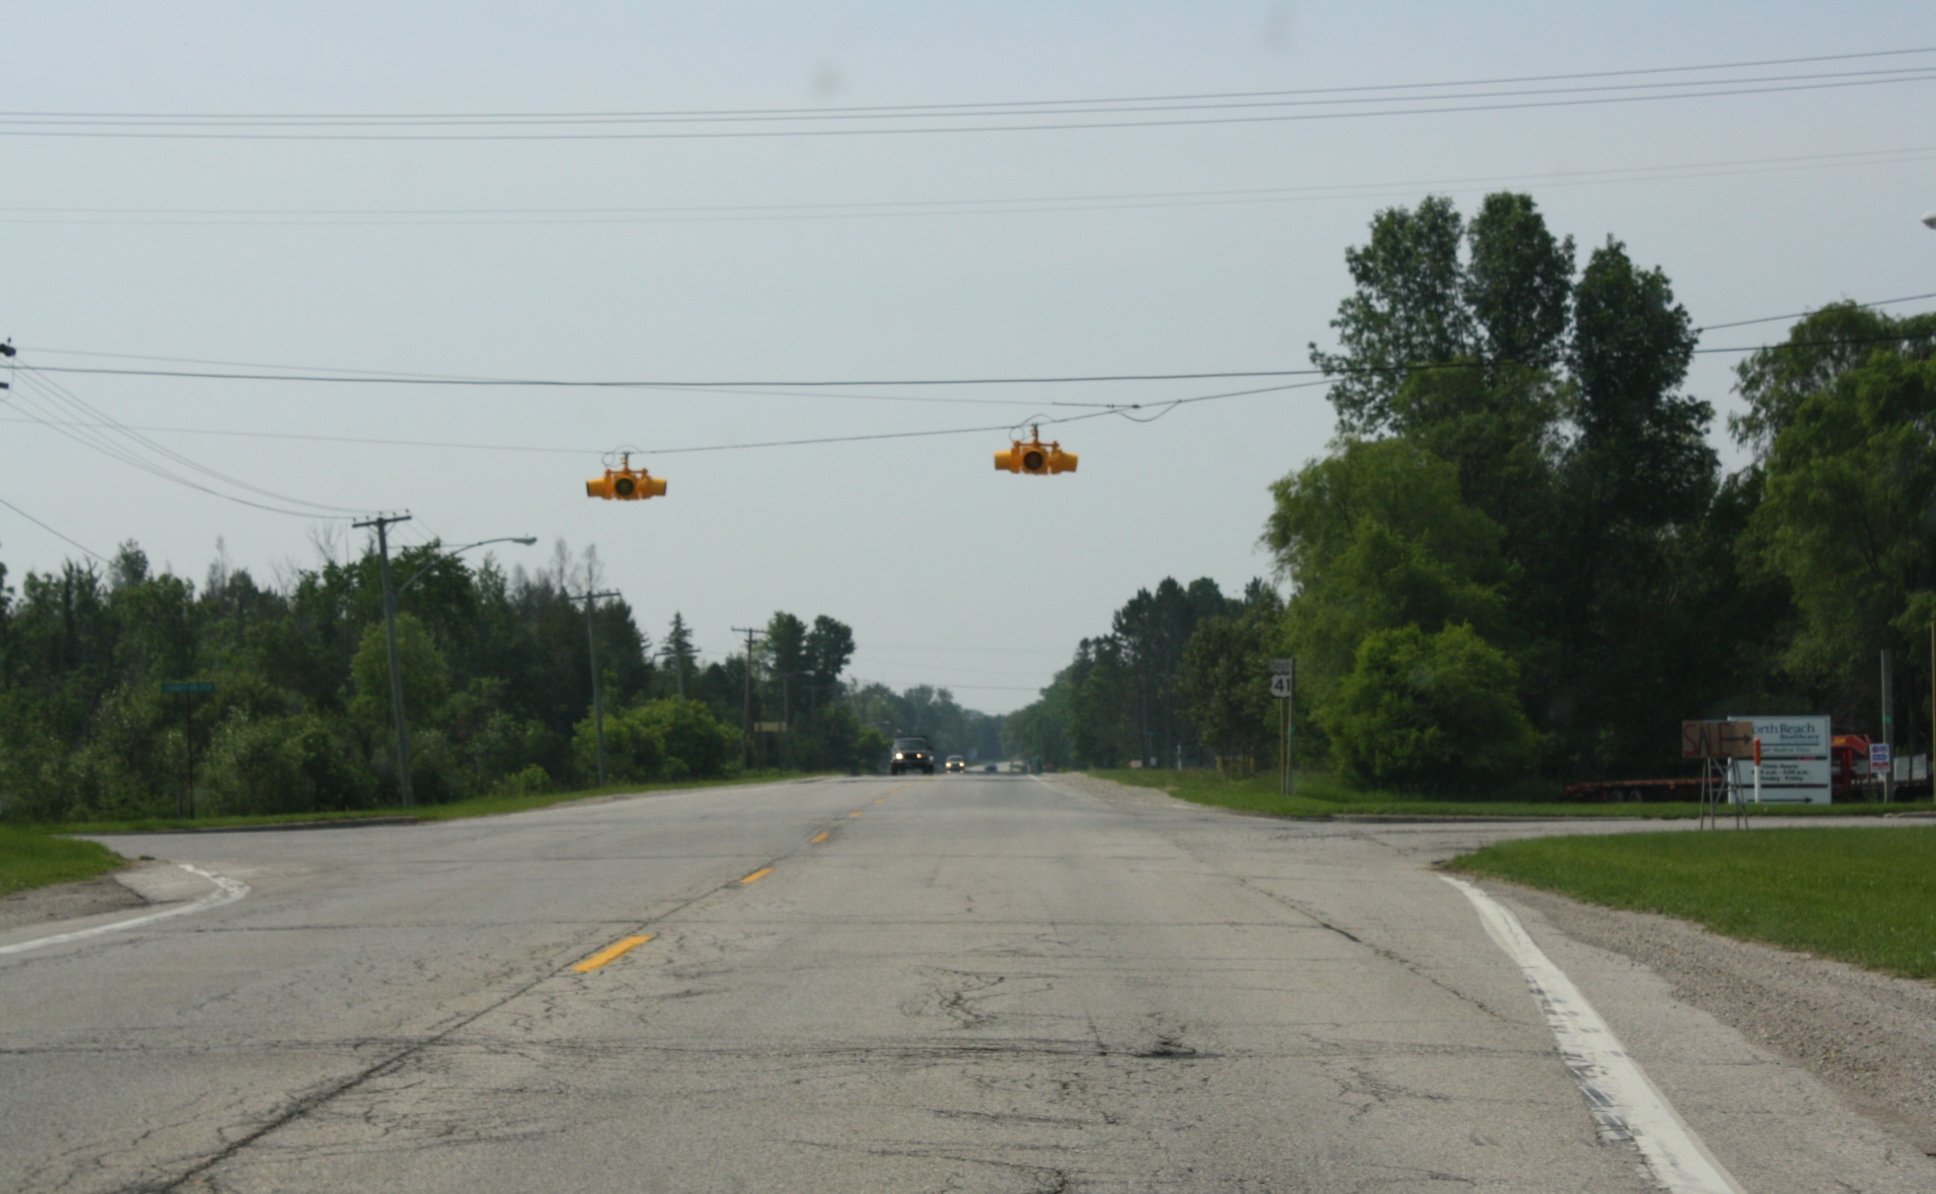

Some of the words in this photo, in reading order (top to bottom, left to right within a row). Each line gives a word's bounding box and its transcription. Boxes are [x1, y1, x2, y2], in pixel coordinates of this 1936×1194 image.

[1274, 678, 1290, 692] 41
[1753, 723, 1778, 734] orth
[1780, 722, 1815, 734] Reach
[1683, 723, 1732, 757] SALE
